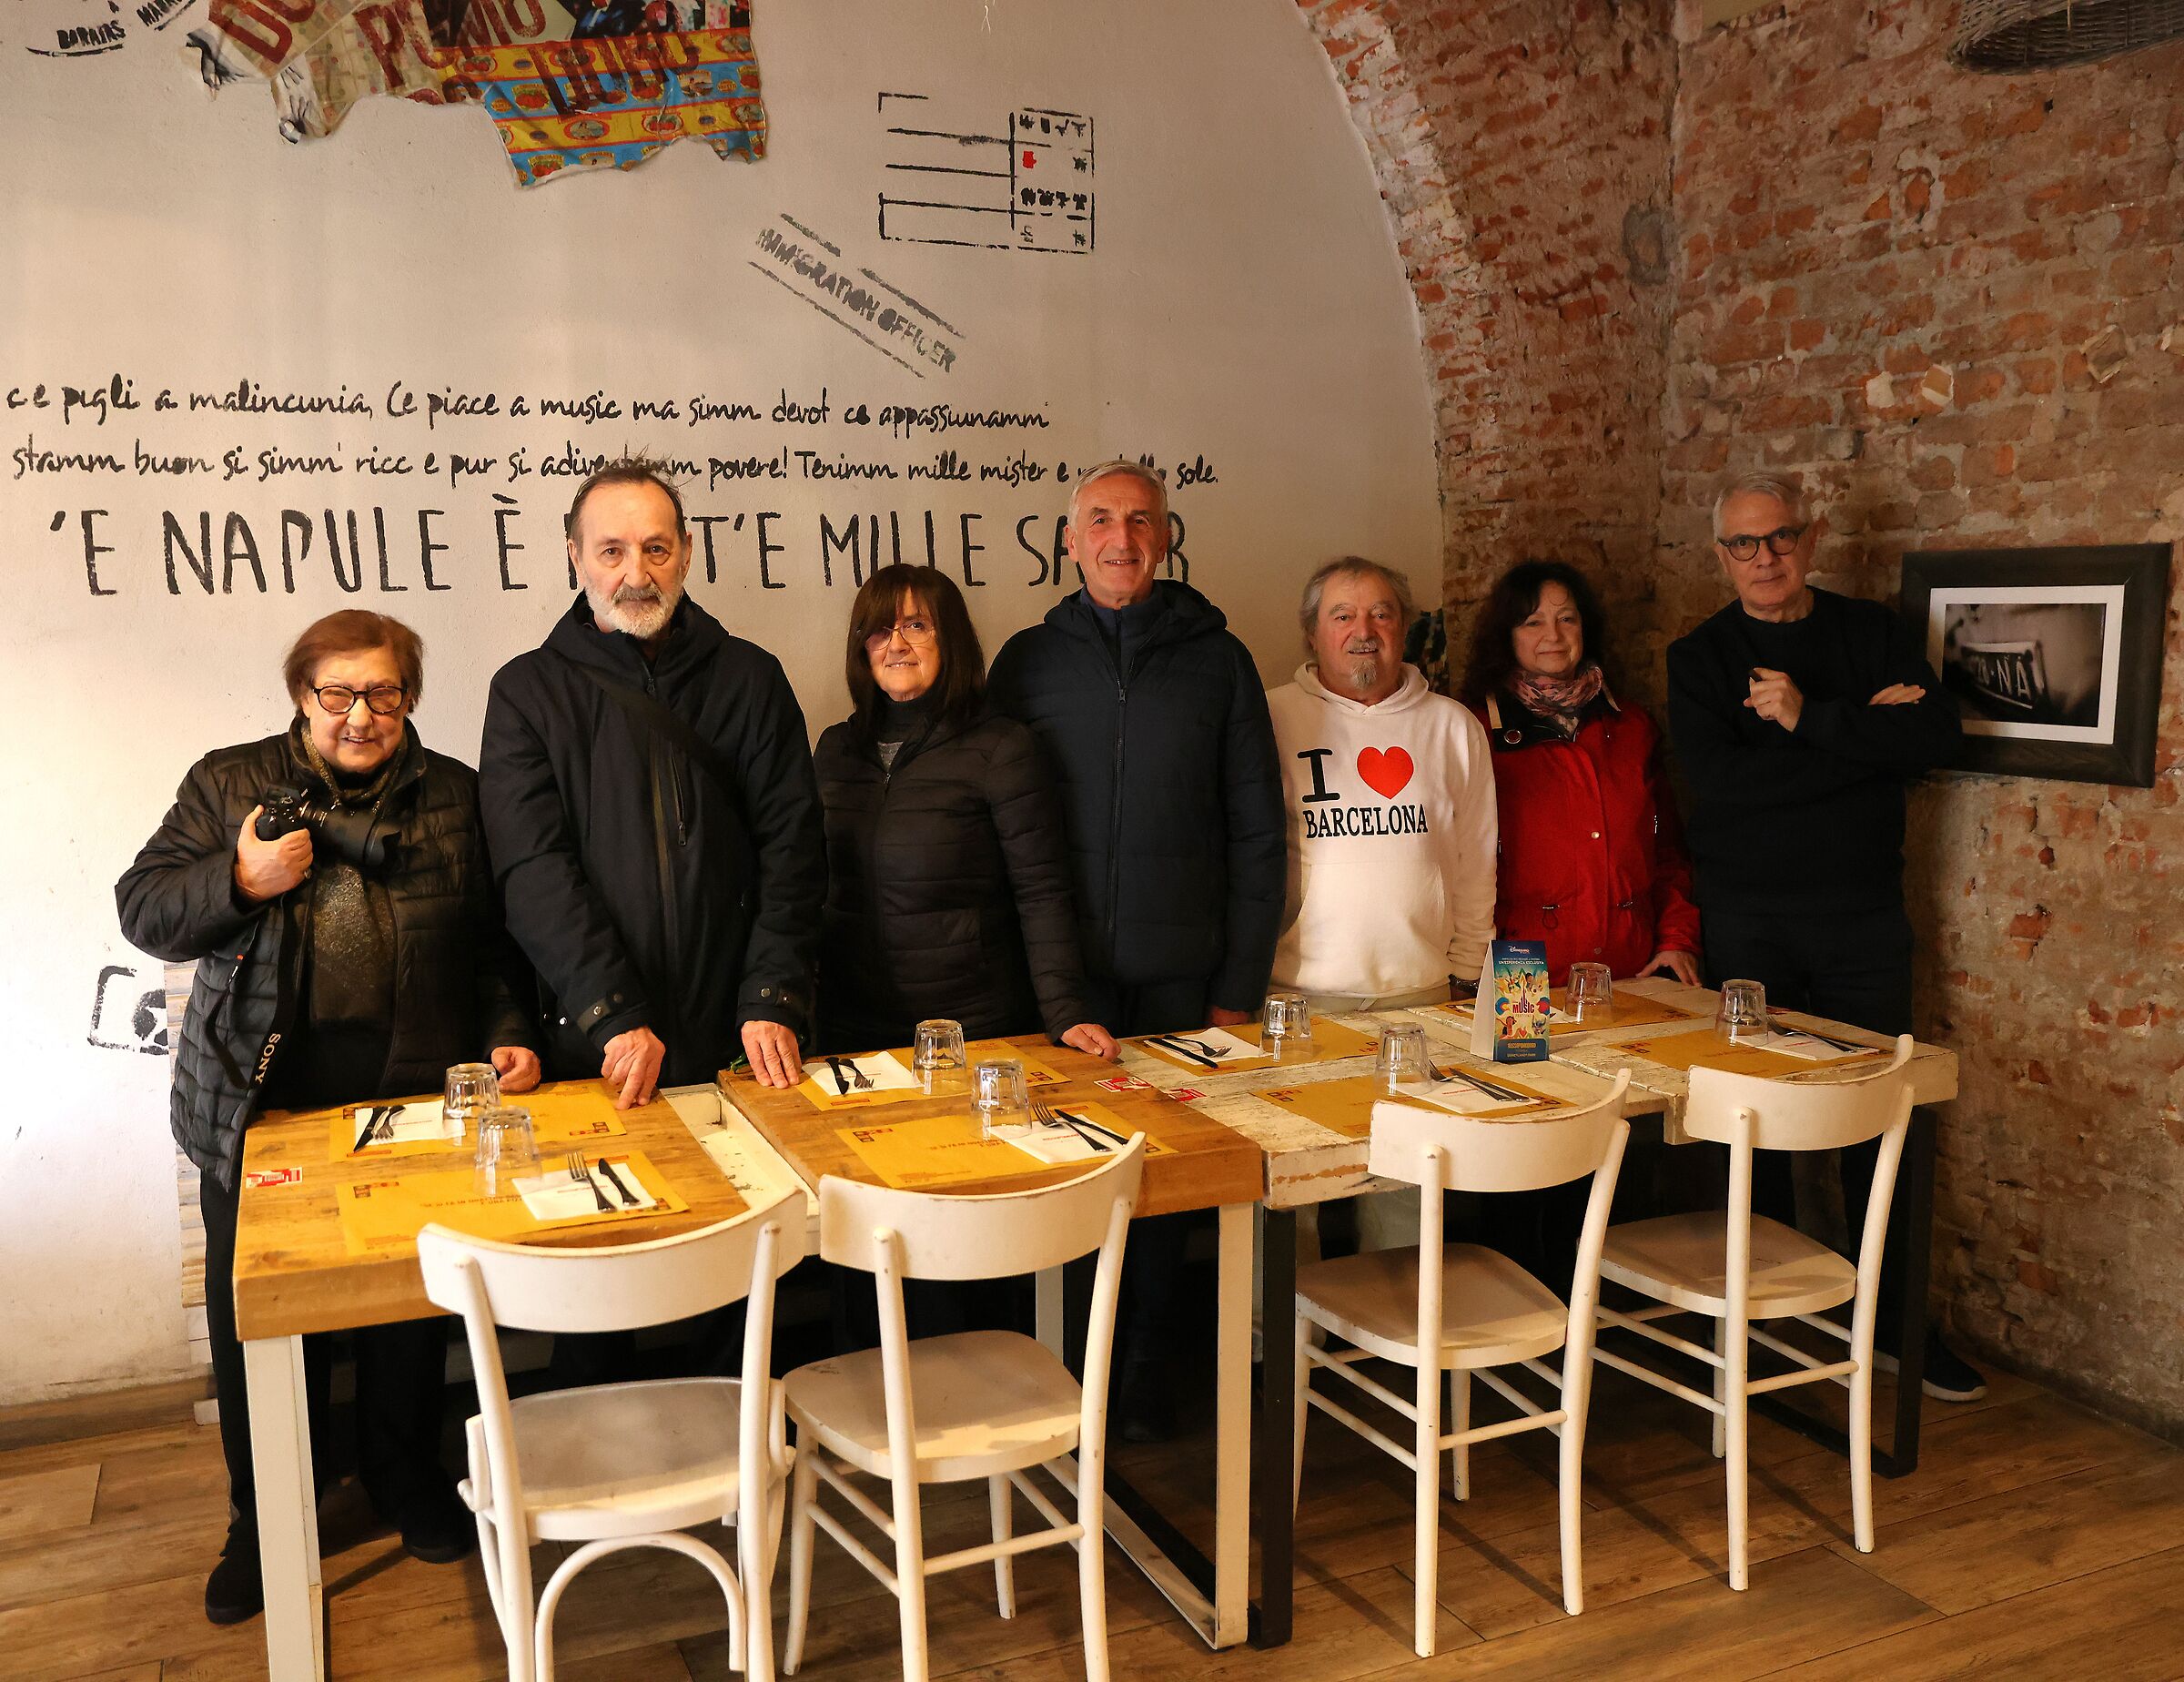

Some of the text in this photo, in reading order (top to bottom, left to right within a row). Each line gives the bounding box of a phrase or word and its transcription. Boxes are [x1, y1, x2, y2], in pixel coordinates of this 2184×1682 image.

[877, 308, 956, 373] OFFICER
[61, 373, 140, 425] pigli
[155, 389, 178, 412] a
[189, 378, 373, 420] malincunia,
[426, 386, 500, 431] piace
[509, 394, 531, 417] a
[540, 390, 622, 425] music
[632, 399, 681, 422] ma
[688, 392, 763, 427] simm
[771, 387, 830, 425] devot
[134, 438, 215, 476] buon
[222, 445, 249, 481] si
[356, 445, 414, 475] ricc
[423, 451, 440, 475] e
[450, 453, 498, 490] pur
[507, 446, 532, 483] si
[707, 445, 788, 492] povere!
[793, 451, 899, 481] Tenimm
[907, 449, 972, 481] mille
[979, 449, 1049, 489] mister
[1056, 461, 1070, 484] e
[49, 508, 118, 597] 'E
[161, 506, 452, 596] NAPULE
[491, 492, 529, 592] È
[819, 510, 987, 589] MILLE
[1297, 748, 1340, 804] I
[1302, 803, 1429, 839] BARCELONA
[1512, 998, 1535, 1014] MUSIC
[255, 1032, 281, 1084] SONY
